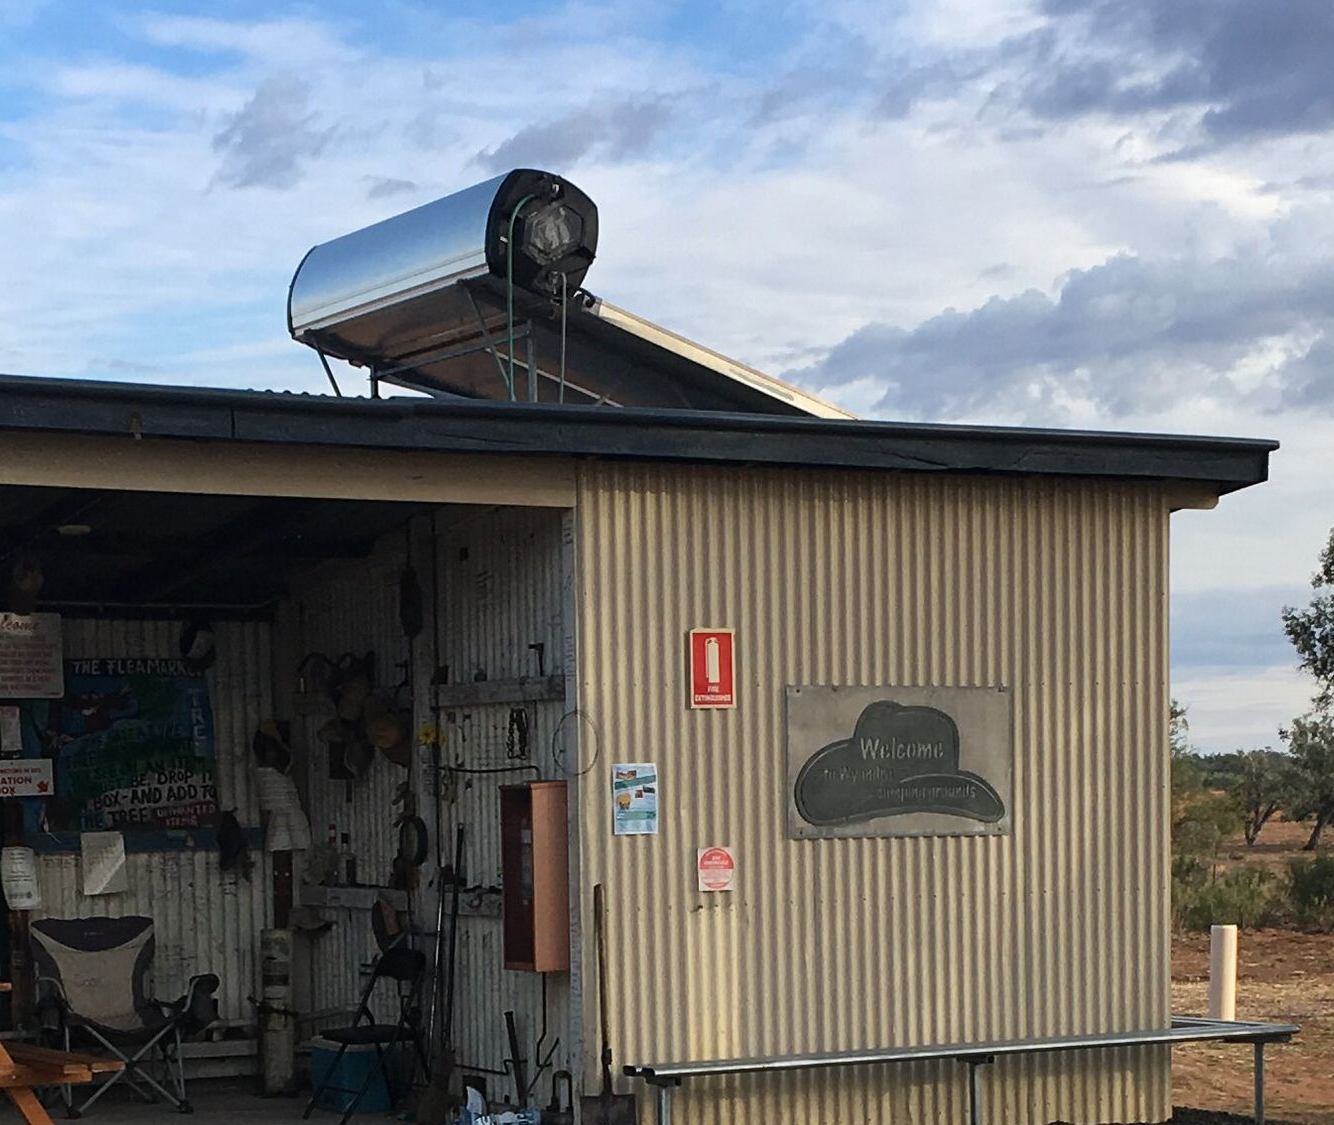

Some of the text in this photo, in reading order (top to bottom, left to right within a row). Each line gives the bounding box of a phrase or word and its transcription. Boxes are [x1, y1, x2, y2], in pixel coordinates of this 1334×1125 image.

[72, 657, 202, 677] THE FLEAMARK
[859, 736, 945, 761] Welcome
[157, 768, 194, 785] DROP
[166, 784, 198, 802] ADD
[200, 784, 218, 800] TO
[107, 807, 149, 825] TREE
